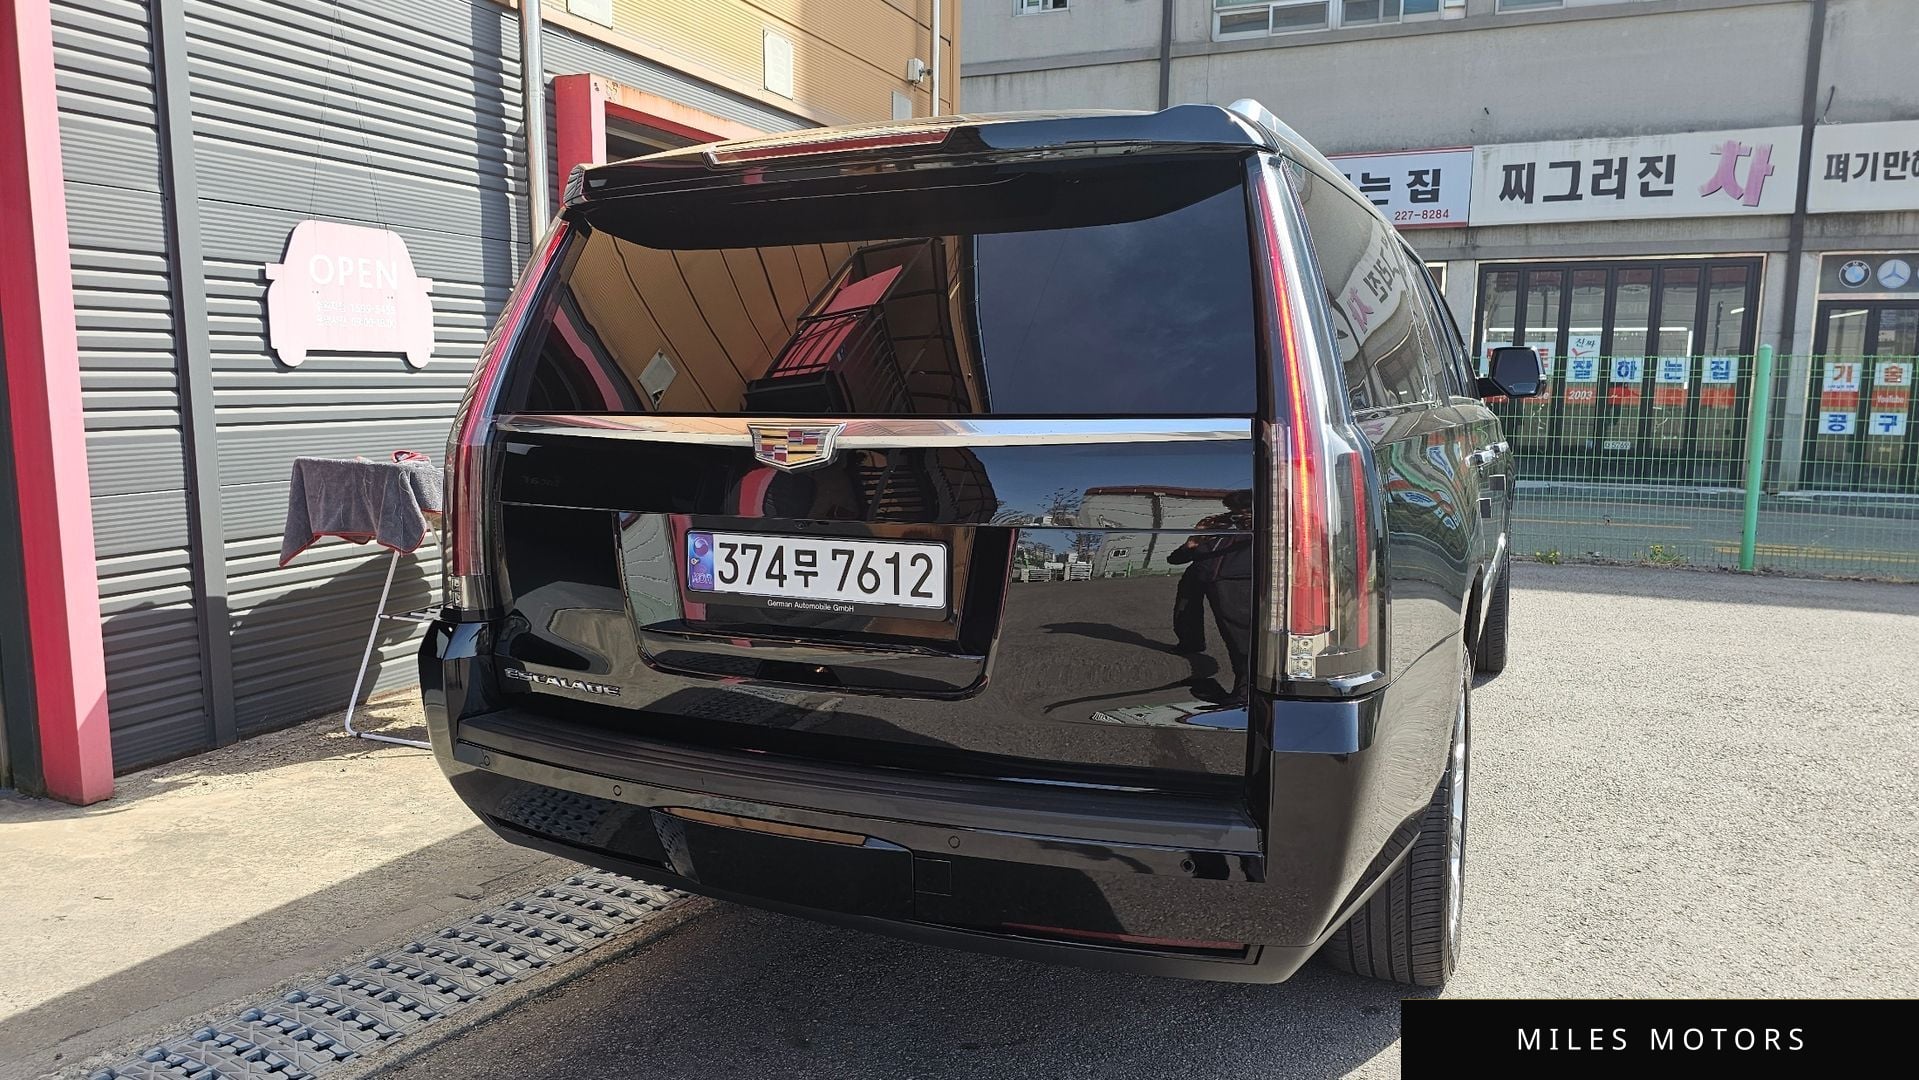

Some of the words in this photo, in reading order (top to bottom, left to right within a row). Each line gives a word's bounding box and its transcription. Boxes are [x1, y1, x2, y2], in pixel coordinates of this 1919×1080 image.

[1406, 168, 1441, 204] 집
[1499, 154, 1675, 204] 찌그러진
[1699, 140, 1775, 207] 차
[1394, 208, 1449, 221] 227-8284
[309, 254, 398, 290] OPEN
[1568, 390, 1593, 400] 2003
[718, 542, 819, 588] 374무
[831, 548, 933, 598] 7612
[767, 599, 791, 609] German
[794, 600, 831, 611] Automobile
[832, 603, 854, 612] GmbH
[504, 667, 621, 696] ESCALADE
